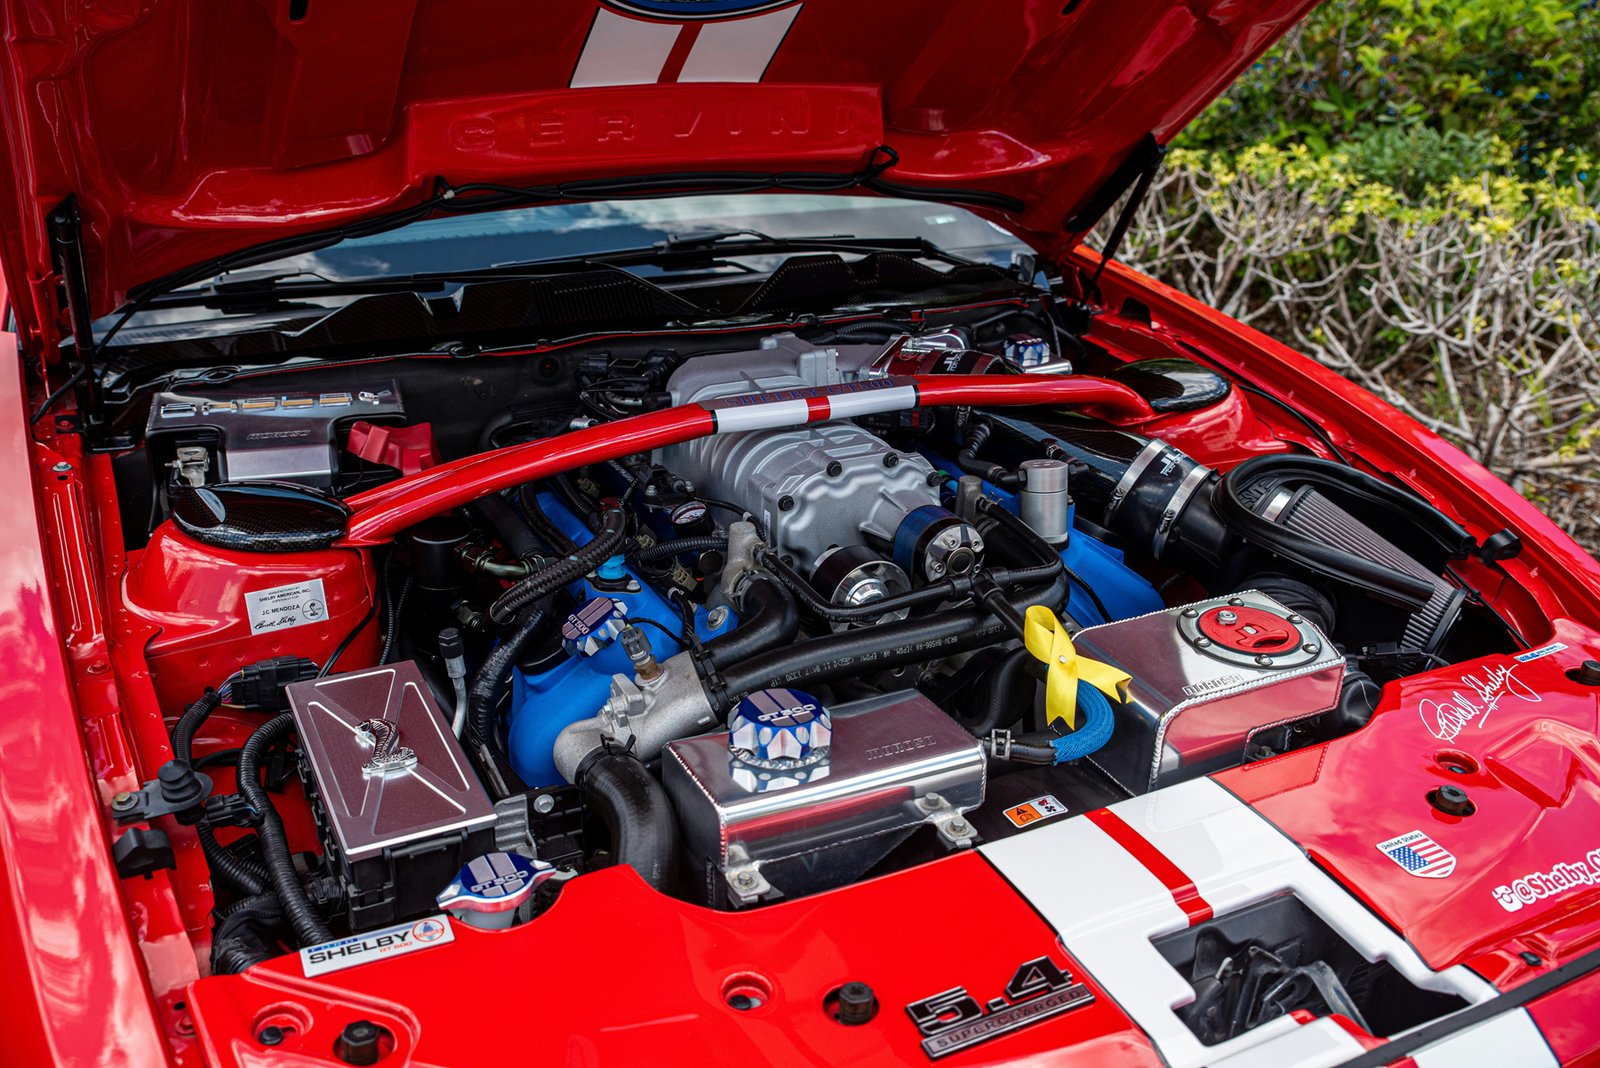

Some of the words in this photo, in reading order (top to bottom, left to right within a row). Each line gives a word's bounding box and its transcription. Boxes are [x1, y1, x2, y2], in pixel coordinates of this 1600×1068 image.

[725, 389, 818, 407] SHELBY
[277, 591, 301, 599] AMERICAN,
[271, 604, 301, 613] MENDOZA
[780, 703, 817, 717] 500
[1380, 839, 1403, 850] United
[1401, 832, 1423, 843] States
[493, 870, 529, 886] 500
[308, 930, 411, 965] SHELBY
[905, 955, 1073, 1035] 5.4
[936, 989, 1082, 1048] SUPERCHARGED
